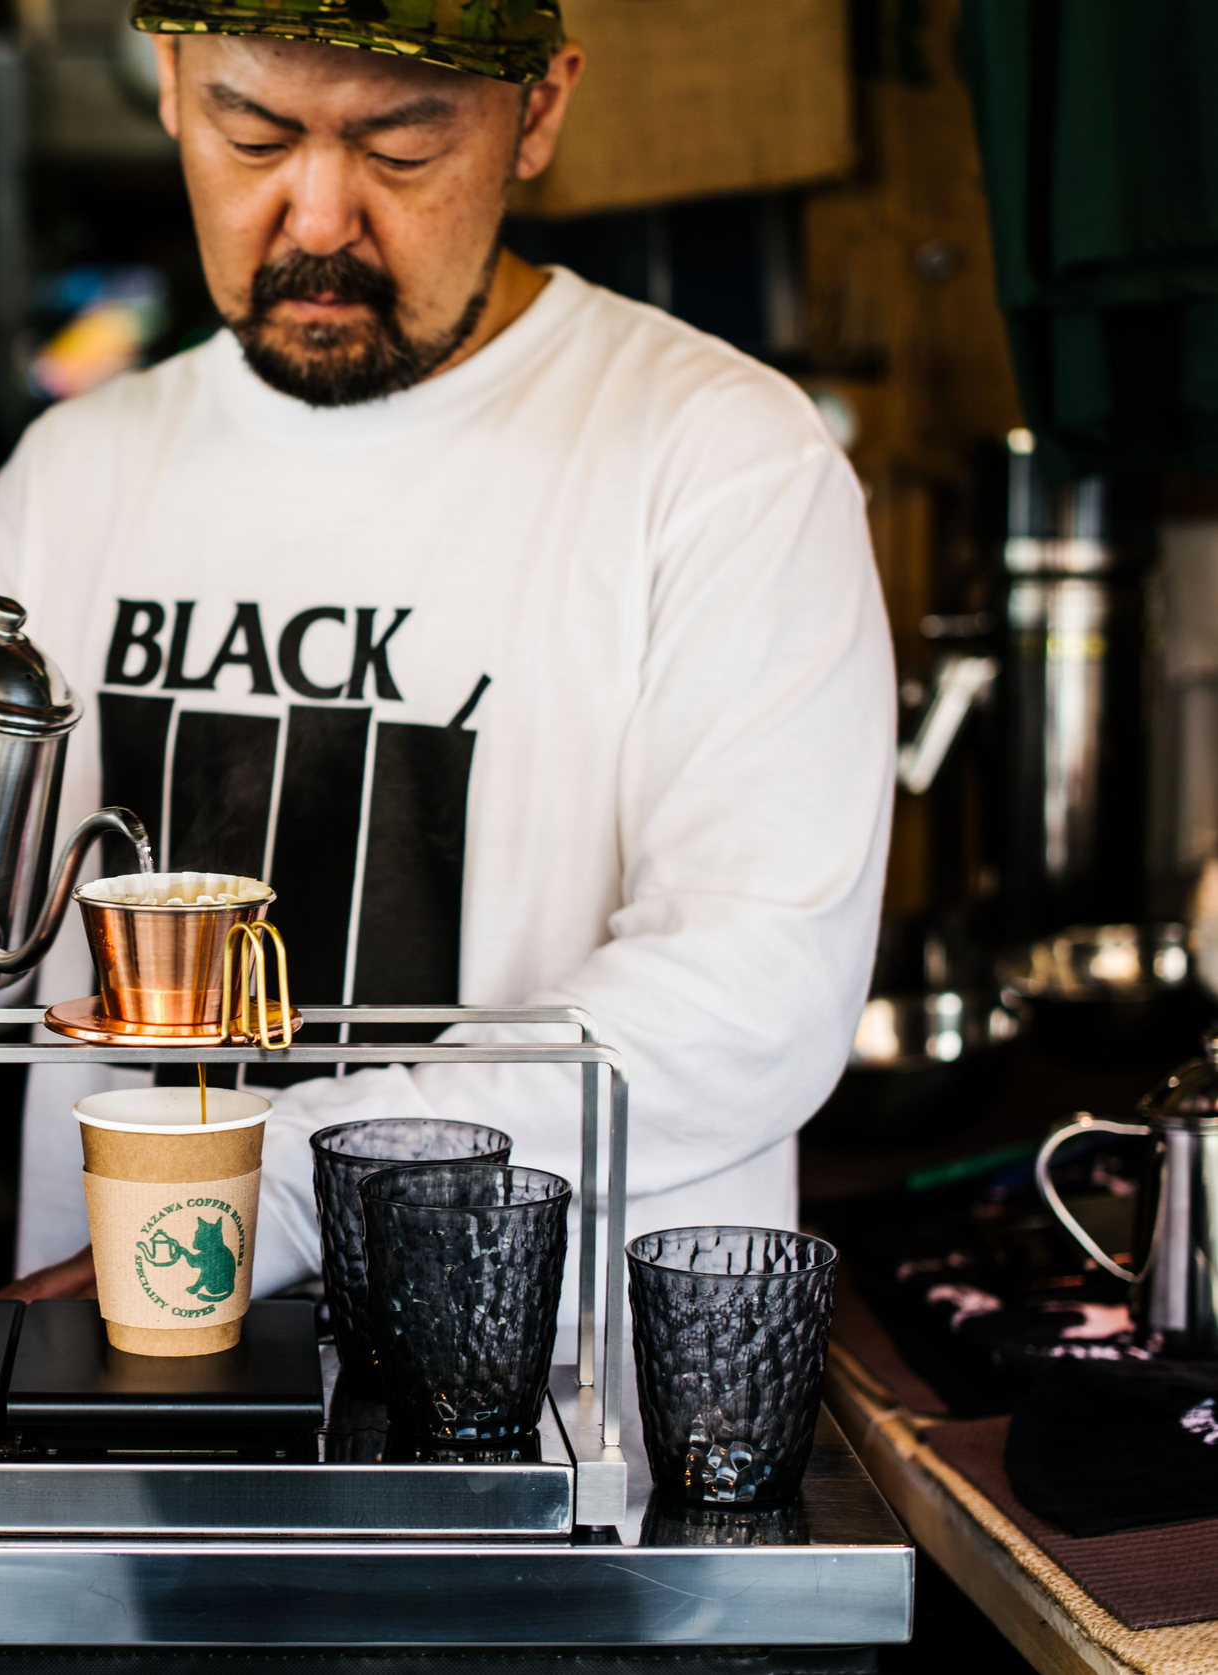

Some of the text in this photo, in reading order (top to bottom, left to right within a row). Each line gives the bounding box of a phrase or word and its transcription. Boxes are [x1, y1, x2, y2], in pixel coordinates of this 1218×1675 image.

[104, 598, 413, 701] BLACK
[140, 1198, 245, 1267] YAZAWA COFFEE ROASTERS
[135, 1254, 216, 1318] SPECIALTY COFFEE
